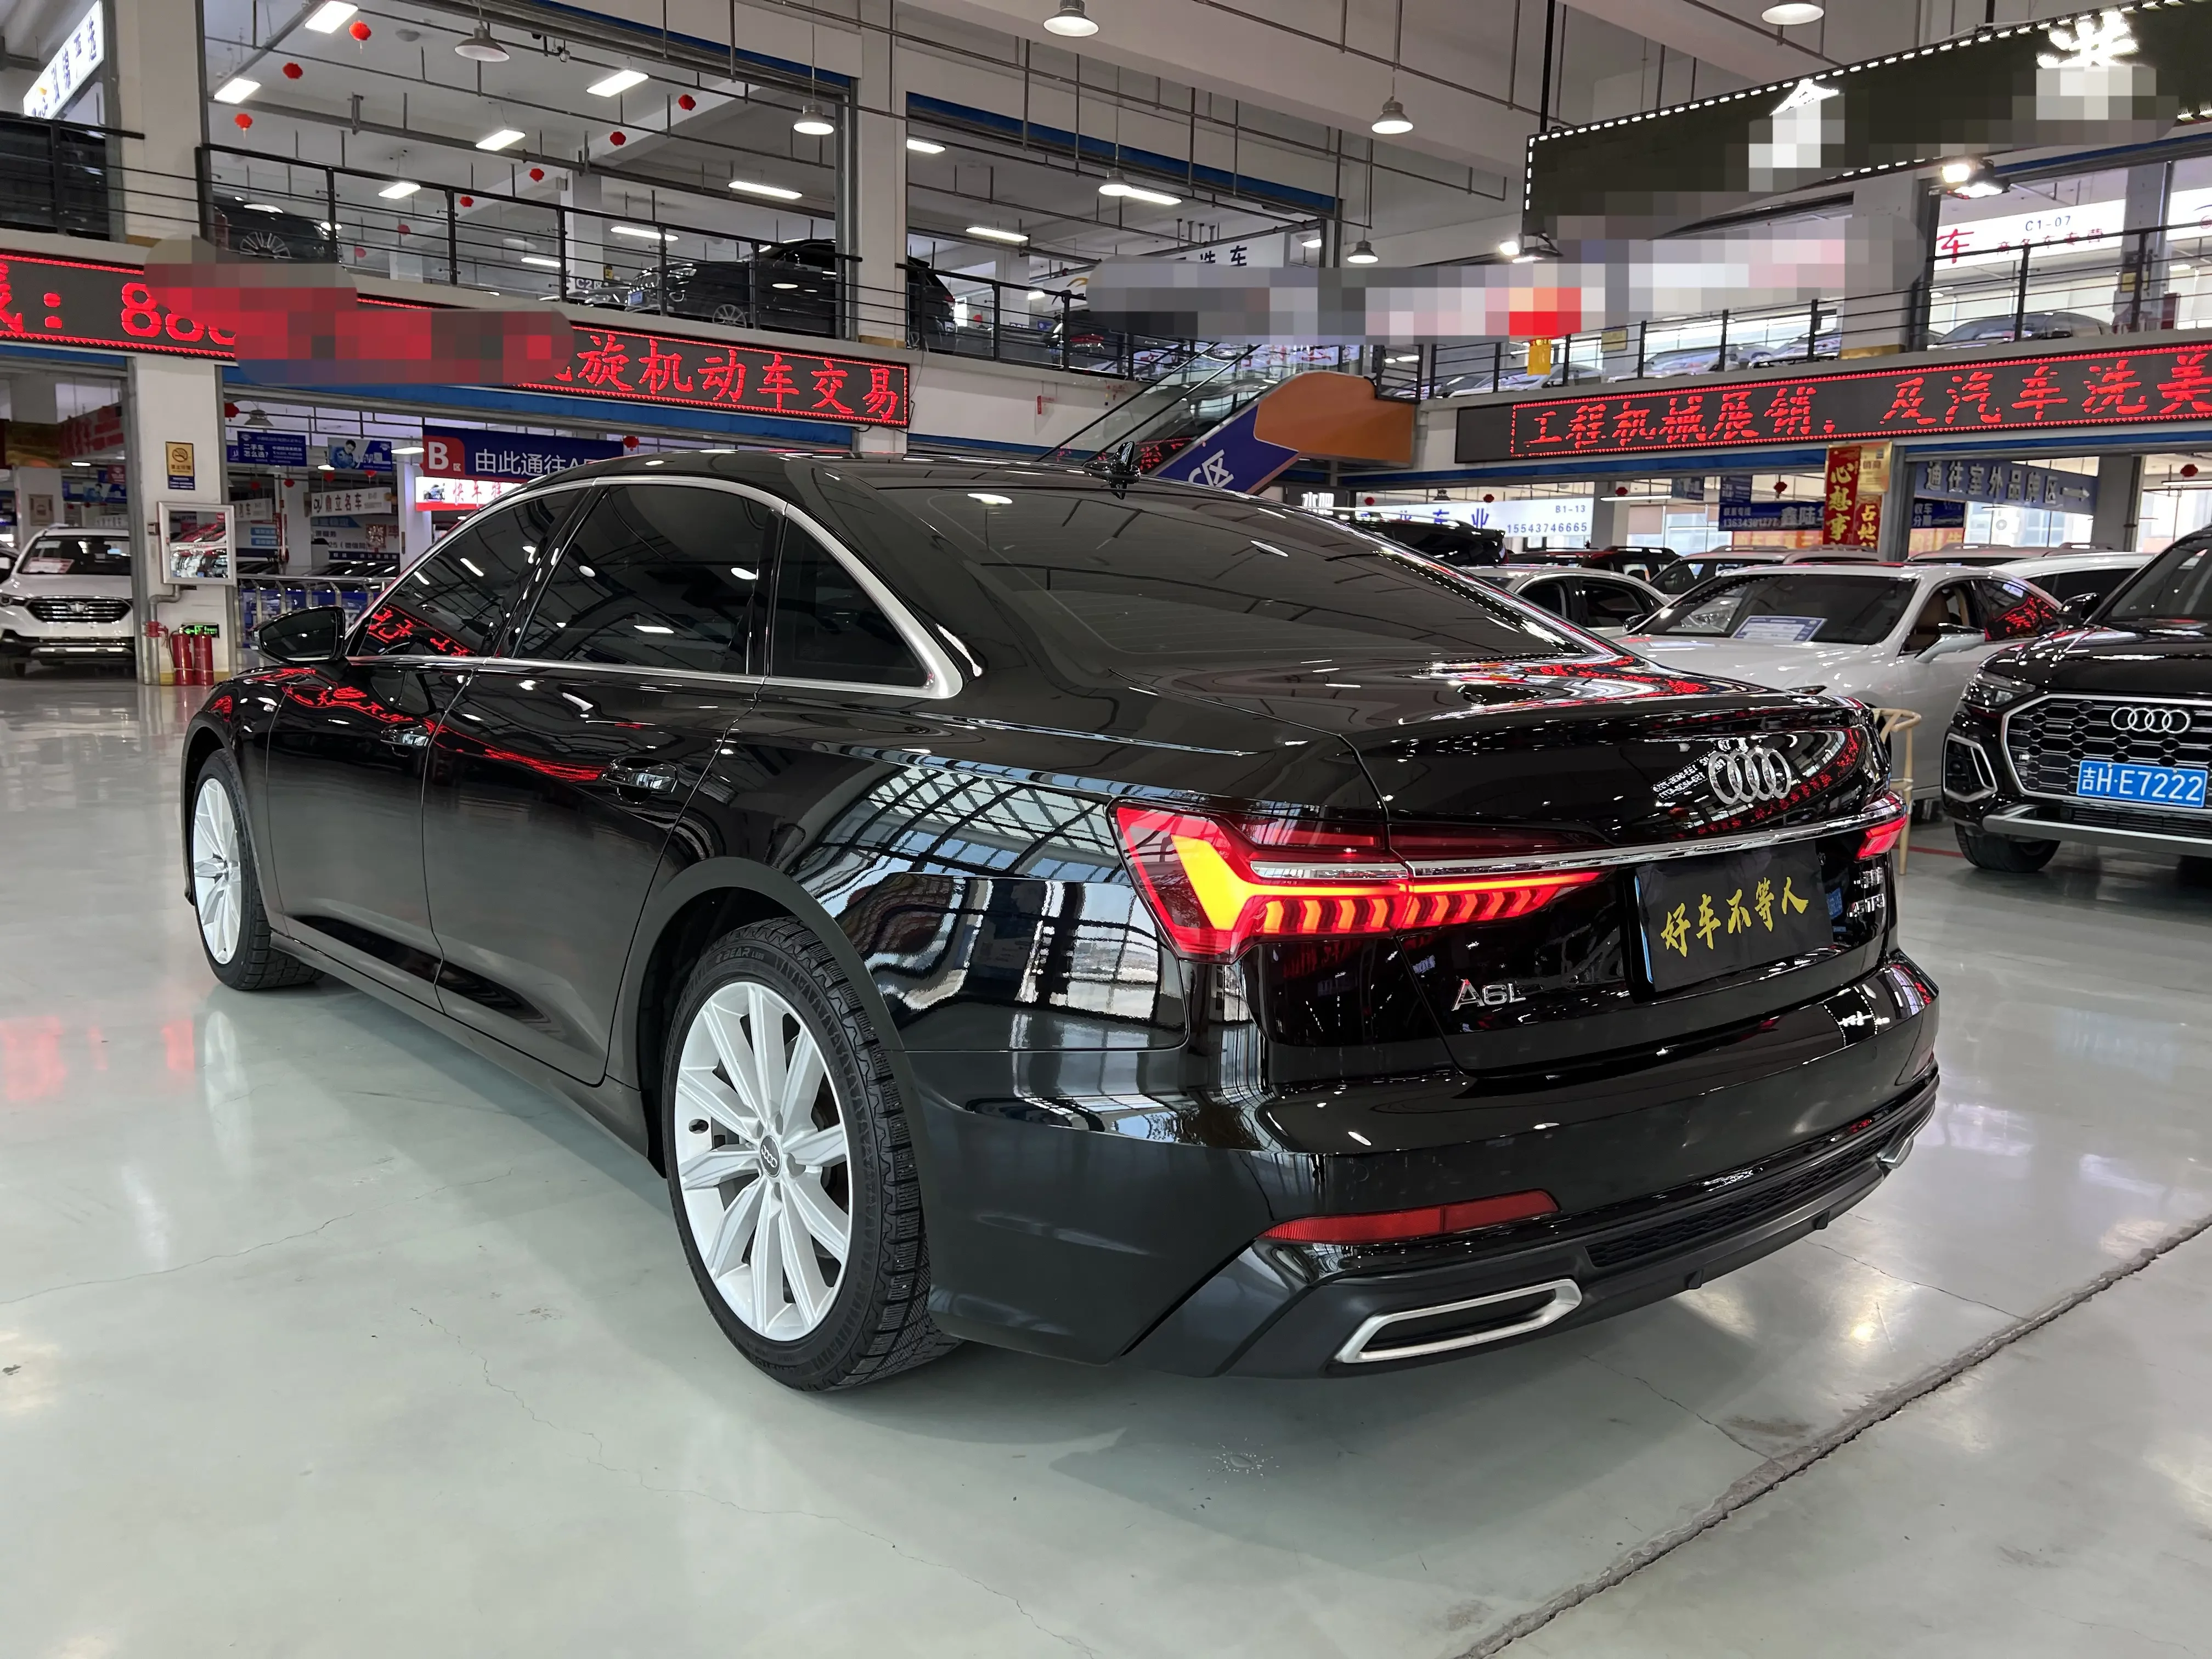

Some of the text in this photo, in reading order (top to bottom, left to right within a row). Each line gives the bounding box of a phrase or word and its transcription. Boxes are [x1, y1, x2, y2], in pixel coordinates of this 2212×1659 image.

[2025, 216, 2071, 232] C1-07
[553, 334, 899, 420] 旋机动车交易
[475, 448, 597, 476] 由此通往
[1360, 508, 1489, 529] 车业
[1555, 505, 1586, 514] B1-13
[1826, 462, 1855, 546] 心想事
[1507, 522, 1587, 534] 15543746665
[1858, 504, 1877, 548] 占地
[1661, 877, 1809, 957] 好车不等人
[1451, 978, 1527, 1011] A6L
